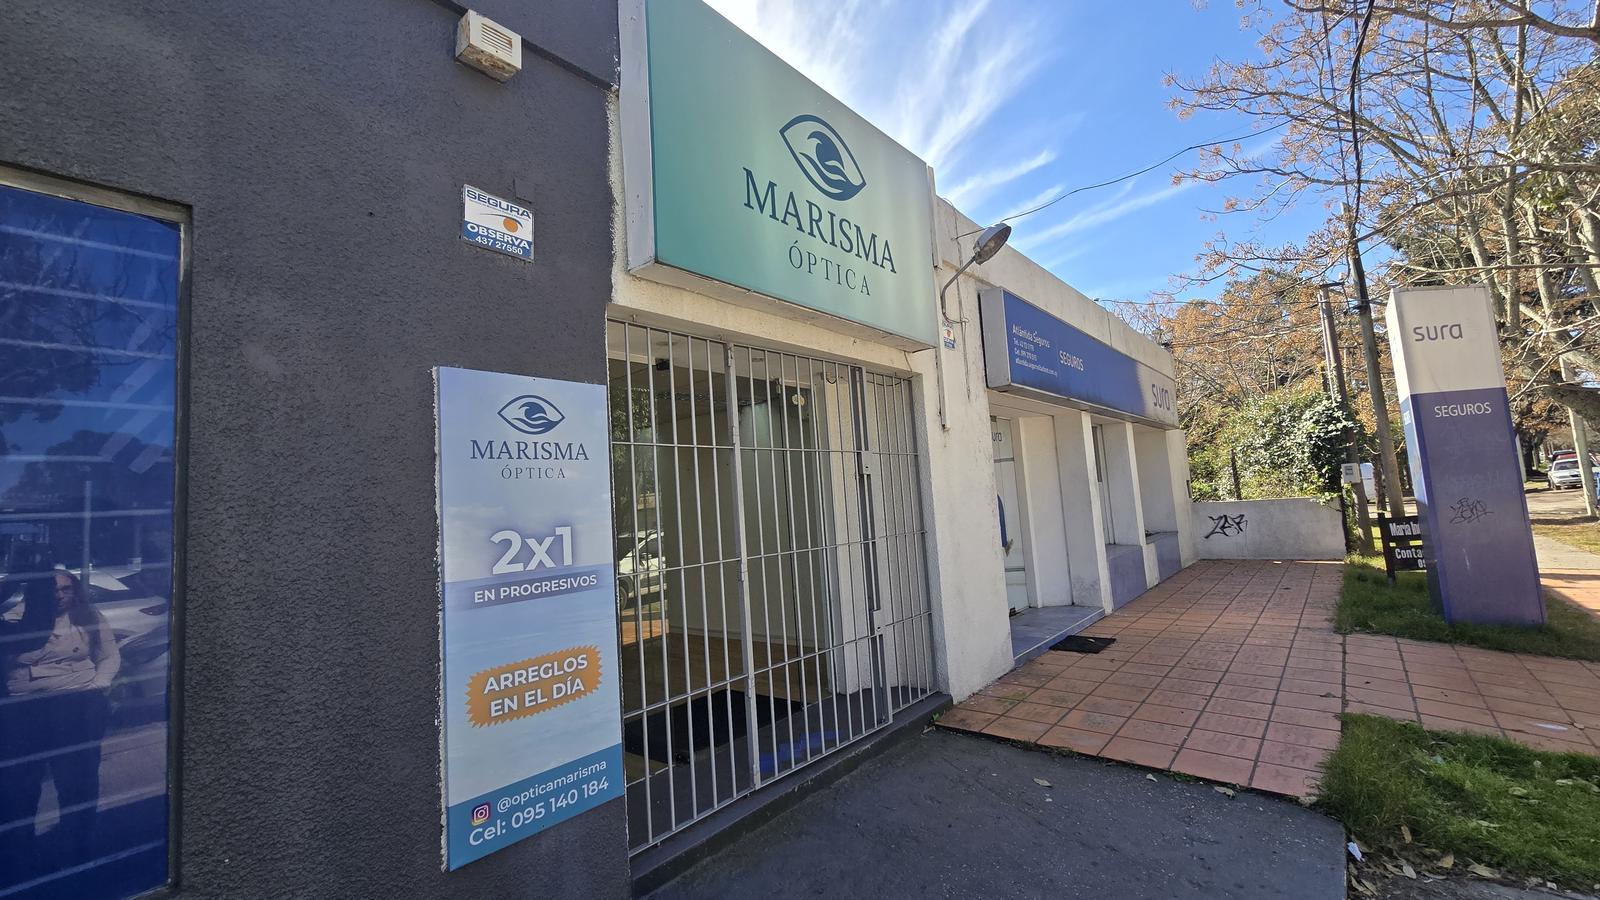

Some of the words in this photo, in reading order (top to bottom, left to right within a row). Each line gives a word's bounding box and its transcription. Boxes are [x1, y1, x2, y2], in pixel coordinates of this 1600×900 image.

[466, 189, 531, 219] SEGURA
[742, 166, 897, 274] MARISMA
[466, 223, 530, 250] OBSERVA
[475, 235, 494, 247] 437
[788, 240, 871, 296] ÓPTICA
[1413, 323, 1463, 342] sura
[1059, 350, 1084, 371] SEGUROS
[1151, 383, 1170, 411] sura
[1434, 402, 1492, 418] SEGUROS
[470, 440, 590, 461] MARISMA
[501, 464, 566, 479] ÓPTICA
[490, 526, 573, 575] 2x1
[1395, 548, 1423, 559] Conta
[474, 589, 496, 603] EN
[500, 574, 597, 599] PROGRESIVOS
[483, 654, 588, 695] ARREGLOS
[490, 695, 518, 717] EN
[524, 688, 548, 708] EL
[552, 675, 585, 700] DÍA
[496, 760, 607, 813] @opticamarisma
[469, 818, 507, 846] Cel:
[511, 802, 546, 829] 095
[549, 789, 578, 813] 140
[582, 775, 609, 799] 184
